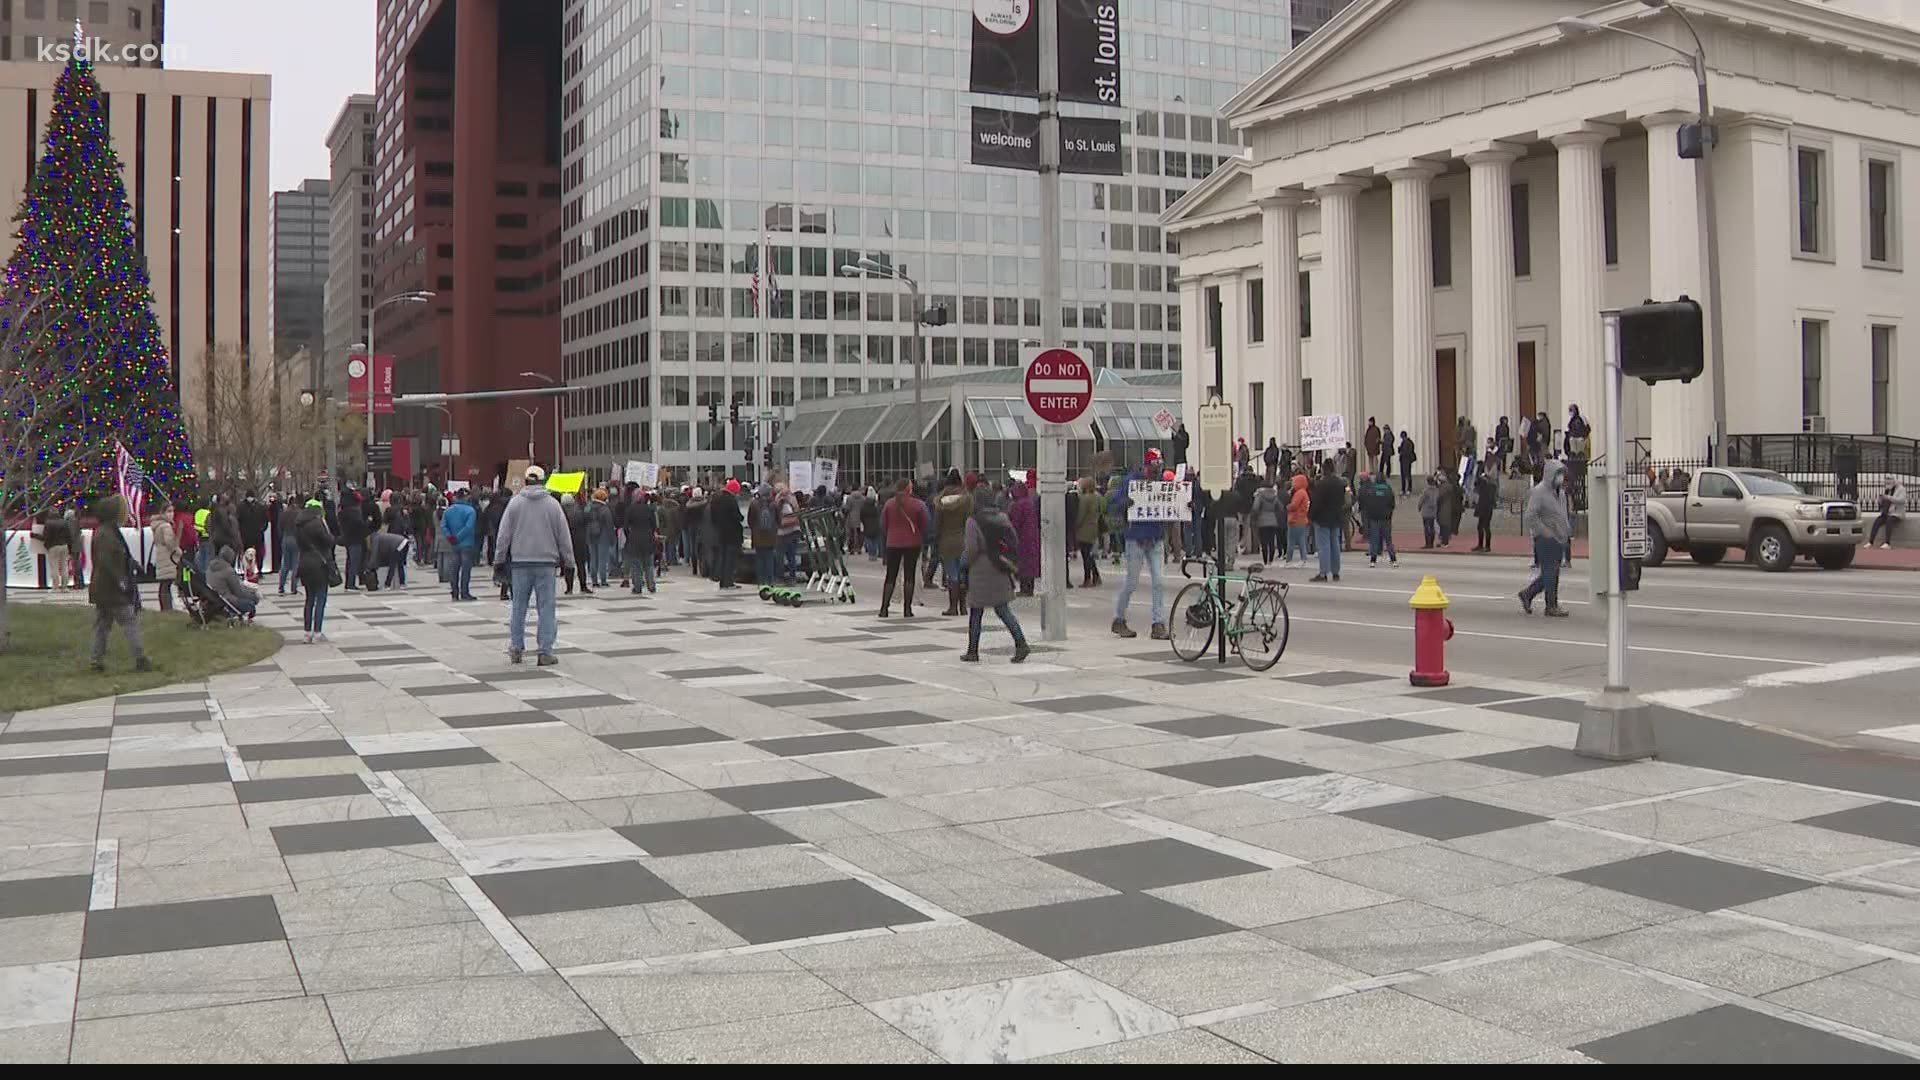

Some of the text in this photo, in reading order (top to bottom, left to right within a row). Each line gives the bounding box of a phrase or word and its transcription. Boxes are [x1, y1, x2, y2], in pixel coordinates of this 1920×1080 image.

[985, 17, 1017, 26] EXPLORING
[1093, 5, 1116, 102] st. louis
[980, 132, 1032, 149] welcome
[1064, 138, 1116, 152] to St. Louis
[1035, 362, 1082, 376] DO NOT
[1040, 396, 1078, 409] ENTER
